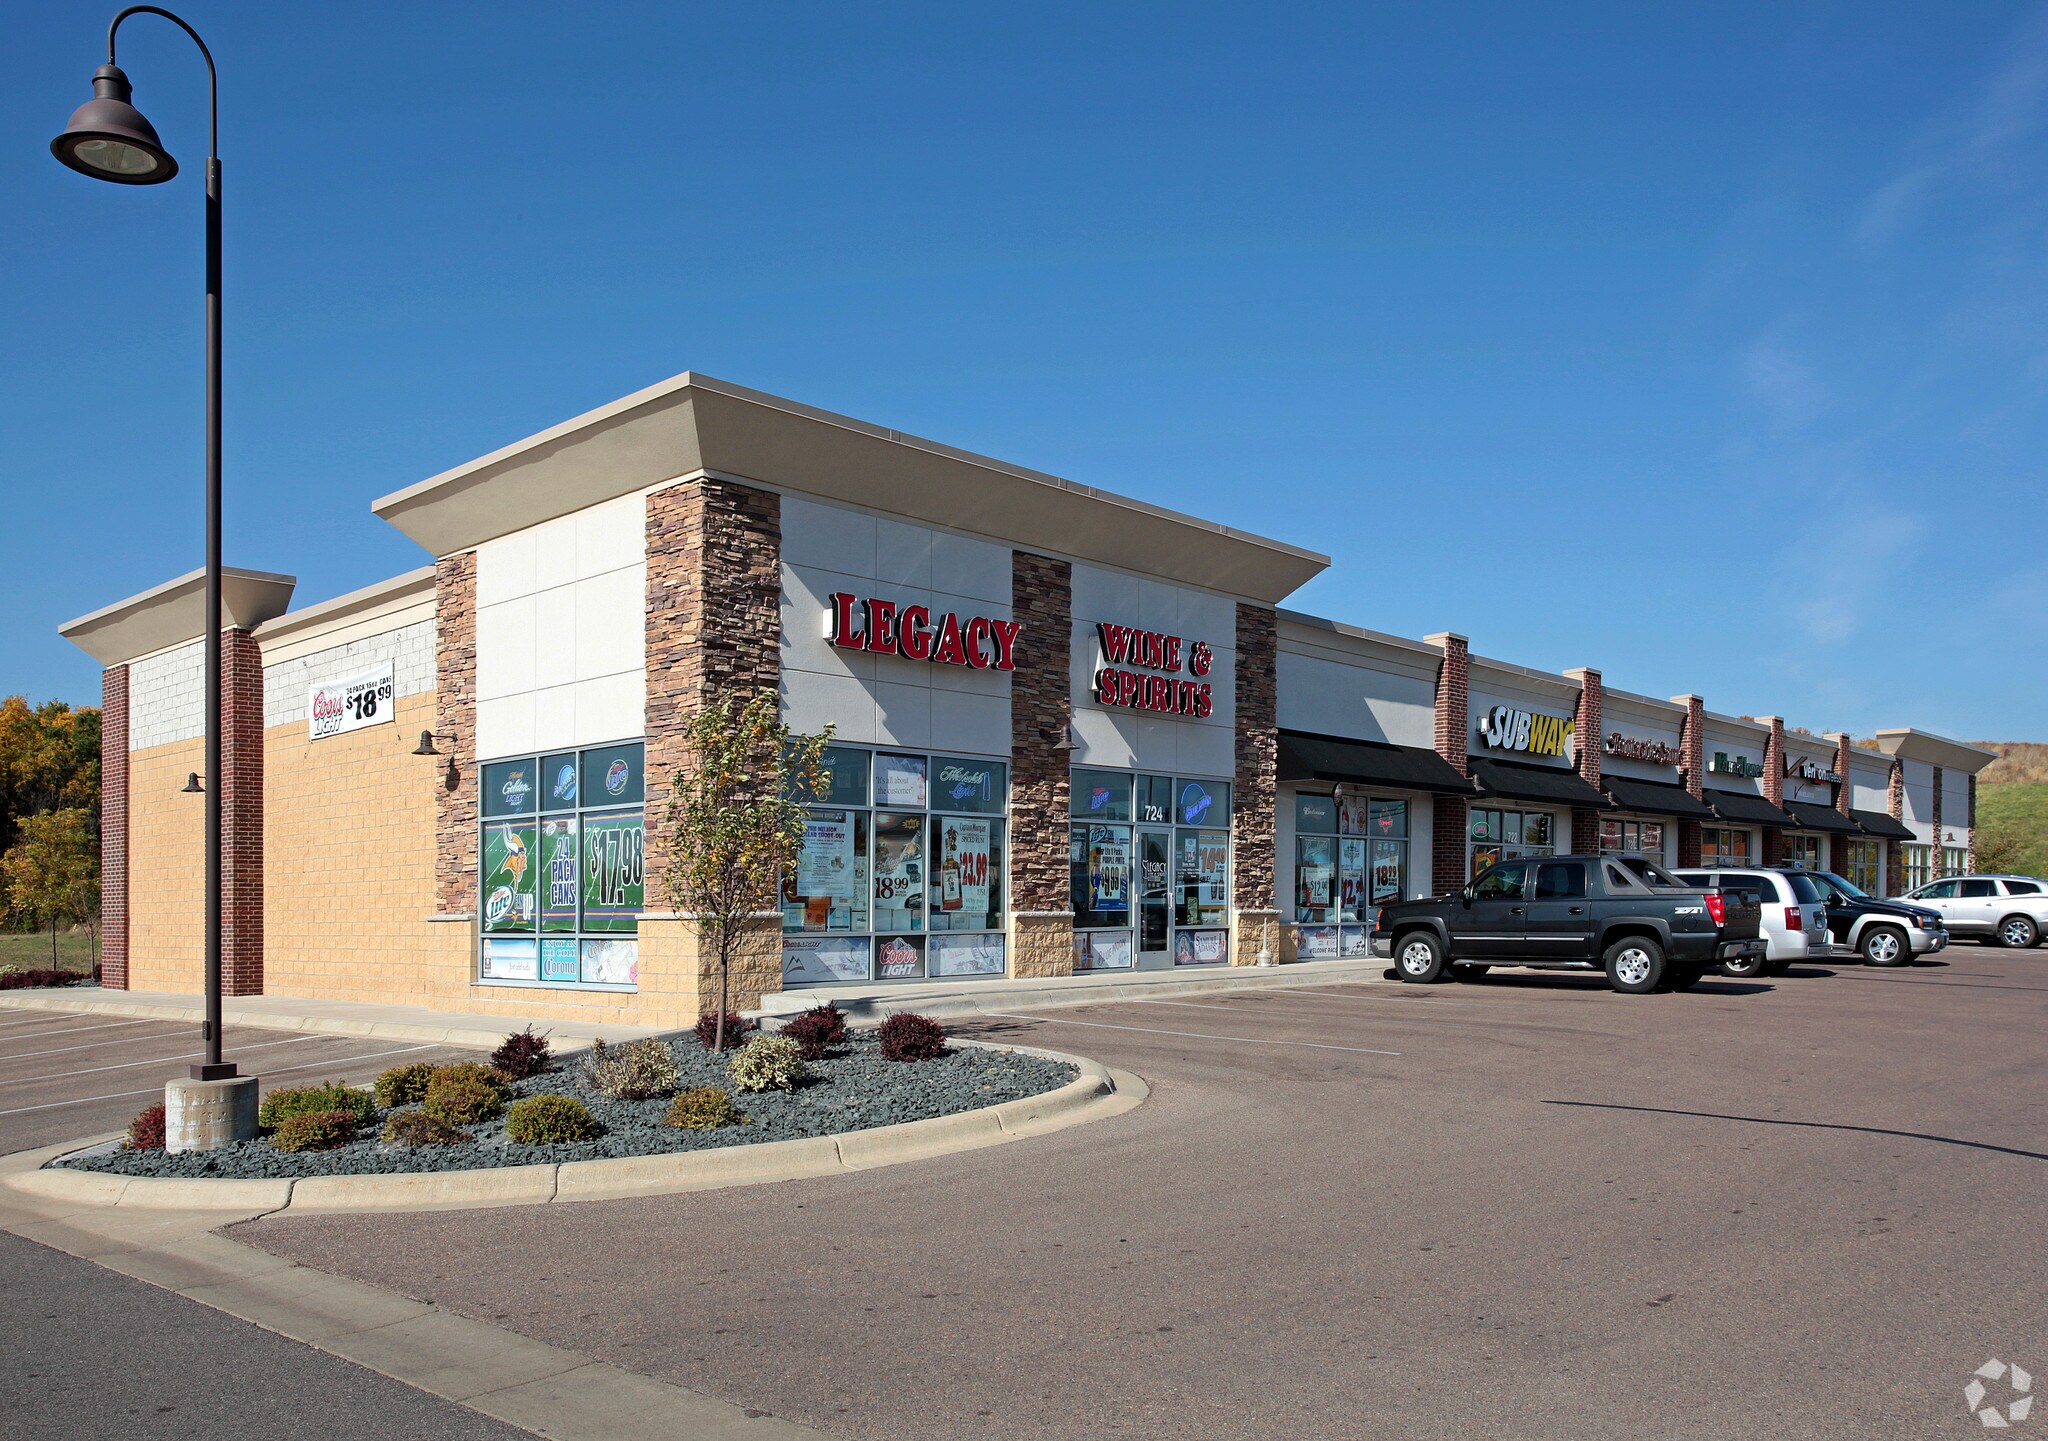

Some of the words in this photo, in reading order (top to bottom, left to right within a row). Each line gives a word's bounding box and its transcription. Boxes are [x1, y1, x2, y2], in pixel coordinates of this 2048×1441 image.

[830, 592, 1021, 671] LEGACY
[1096, 622, 1183, 672] WINE
[1189, 640, 1214, 677] &
[353, 684, 365, 693] PACK
[379, 675, 392, 686] CANS
[1094, 667, 1213, 718] SPIRITS
[313, 689, 343, 720] Coors
[314, 714, 344, 736] LIGHT
[1487, 705, 1576, 756] SUBWAY
[502, 779, 531, 795] Golden
[895, 777, 909, 785] about
[1144, 804, 1163, 821] 724
[557, 836, 570, 859] 24
[961, 835, 975, 843] SPICED
[1507, 831, 1518, 843] 722
[552, 858, 576, 882] PACK
[590, 828, 644, 906] $17.98
[959, 851, 988, 887] $23.99
[1147, 861, 1167, 873] LEGACY
[551, 881, 576, 906] CANS
[488, 895, 510, 920] Lite
[523, 893, 534, 920] UP
[1195, 935, 1218, 947] SAMUEL
[880, 943, 918, 964] Coors
[544, 957, 576, 976] Corona
[880, 964, 915, 977] LIGHT
